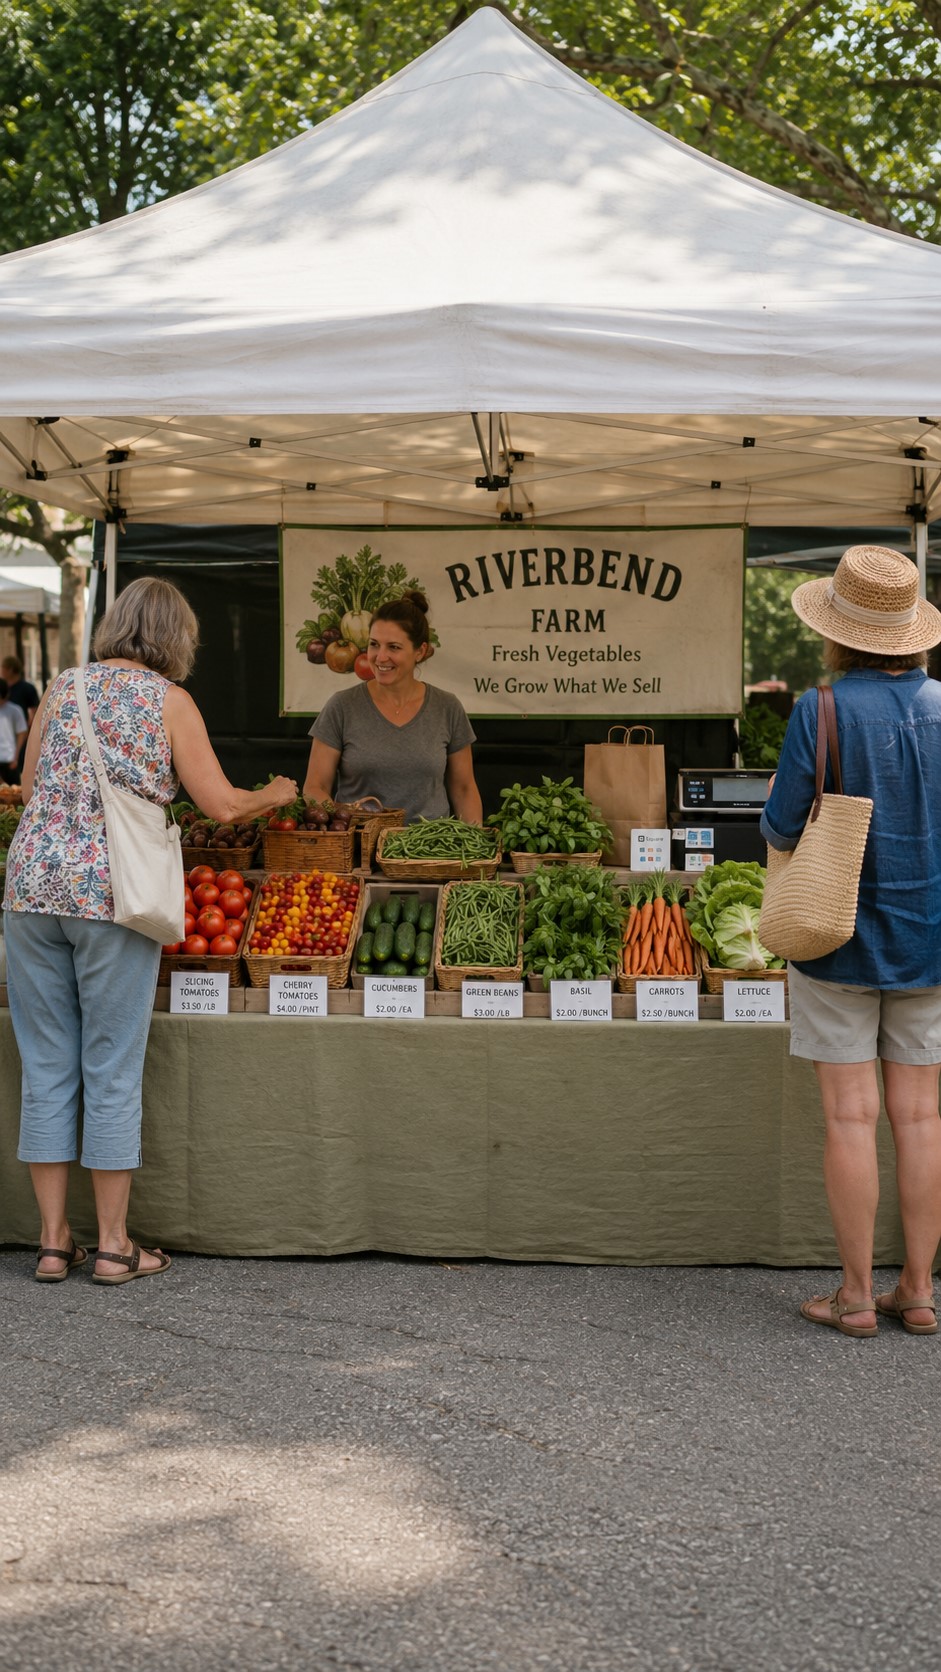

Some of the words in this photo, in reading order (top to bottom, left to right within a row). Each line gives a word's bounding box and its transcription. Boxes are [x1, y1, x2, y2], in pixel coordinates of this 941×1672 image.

[445, 547, 683, 603] RIVERBEND
[531, 609, 606, 633] FARM
[492, 645, 540, 662] Fresh
[545, 645, 642, 667] Vegetables
[474, 677, 499, 693] We
[504, 677, 548, 693] Grow
[553, 677, 597, 693] What
[602, 677, 627, 693] We
[632, 677, 662, 693] Sell
[185, 977, 214, 986] SLICING
[283, 980, 313, 989] CHERRY
[180, 988, 220, 997] TOMATOES
[371, 984, 418, 992] CUCUMBERS
[465, 988, 492, 996] GREEN
[493, 989, 519, 997] BEANS
[570, 987, 592, 995] BASIL
[649, 987, 685, 996] CARROTS
[737, 987, 771, 996] LETTUCE
[278, 991, 319, 1000] TOMATOES
[276, 1004, 297, 1013] $4.00
[298, 1005, 319, 1013] /PINT
[376, 1005, 397, 1013] $2.00
[398, 1005, 413, 1013] /EA
[474, 1008, 495, 1017] $3.00
[497, 1009, 510, 1017] /LB
[556, 1009, 577, 1017] $2.00
[578, 1009, 608, 1017] /BUNCH
[735, 1009, 756, 1017] $2.00
[758, 1009, 773, 1017] /EA
[664, 1009, 695, 1018] /BUNCH
